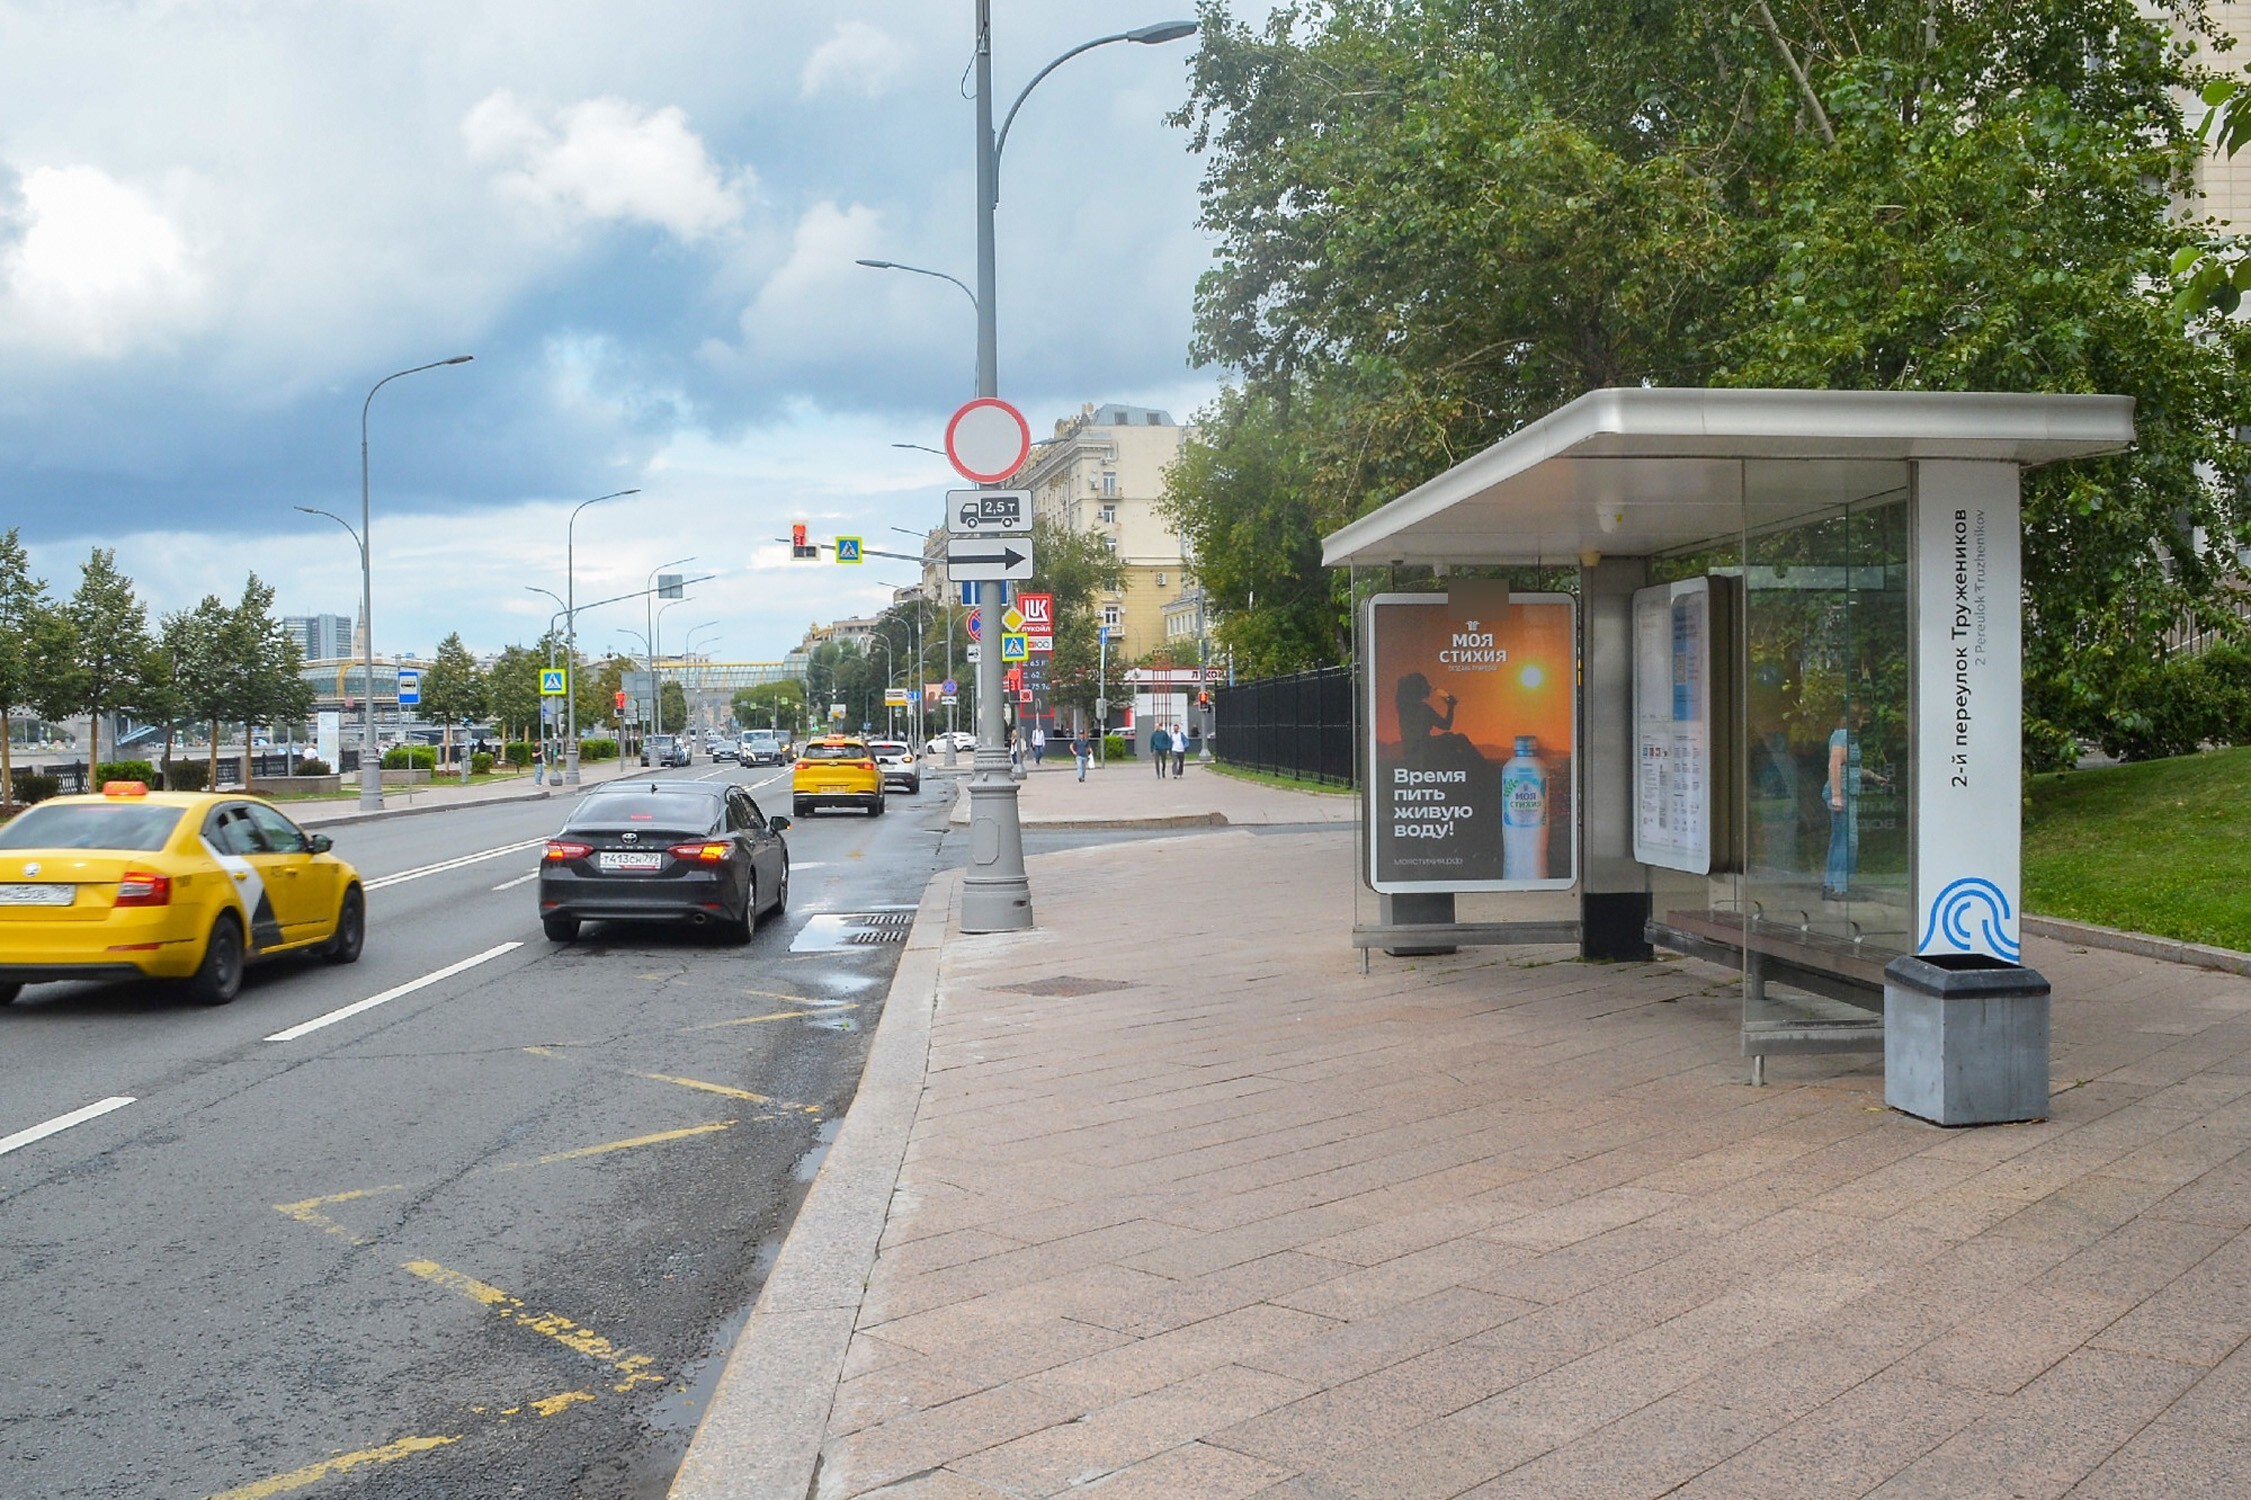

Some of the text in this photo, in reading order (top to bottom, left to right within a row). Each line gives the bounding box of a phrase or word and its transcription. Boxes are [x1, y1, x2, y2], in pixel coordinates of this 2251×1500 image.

[985, 501, 1005, 514] 2,5
[1974, 509, 1986, 666] 2 Pereulok Truzhenikov
[1452, 633, 1493, 647] МОЯ
[1951, 508, 1972, 788] 2-й переулок Тружеников
[1439, 650, 1507, 662] СТИХИЯ
[1393, 768, 1466, 785] Время
[1393, 789, 1446, 801] пить
[1393, 806, 1473, 821] живую
[1393, 821, 1454, 839] воду!
